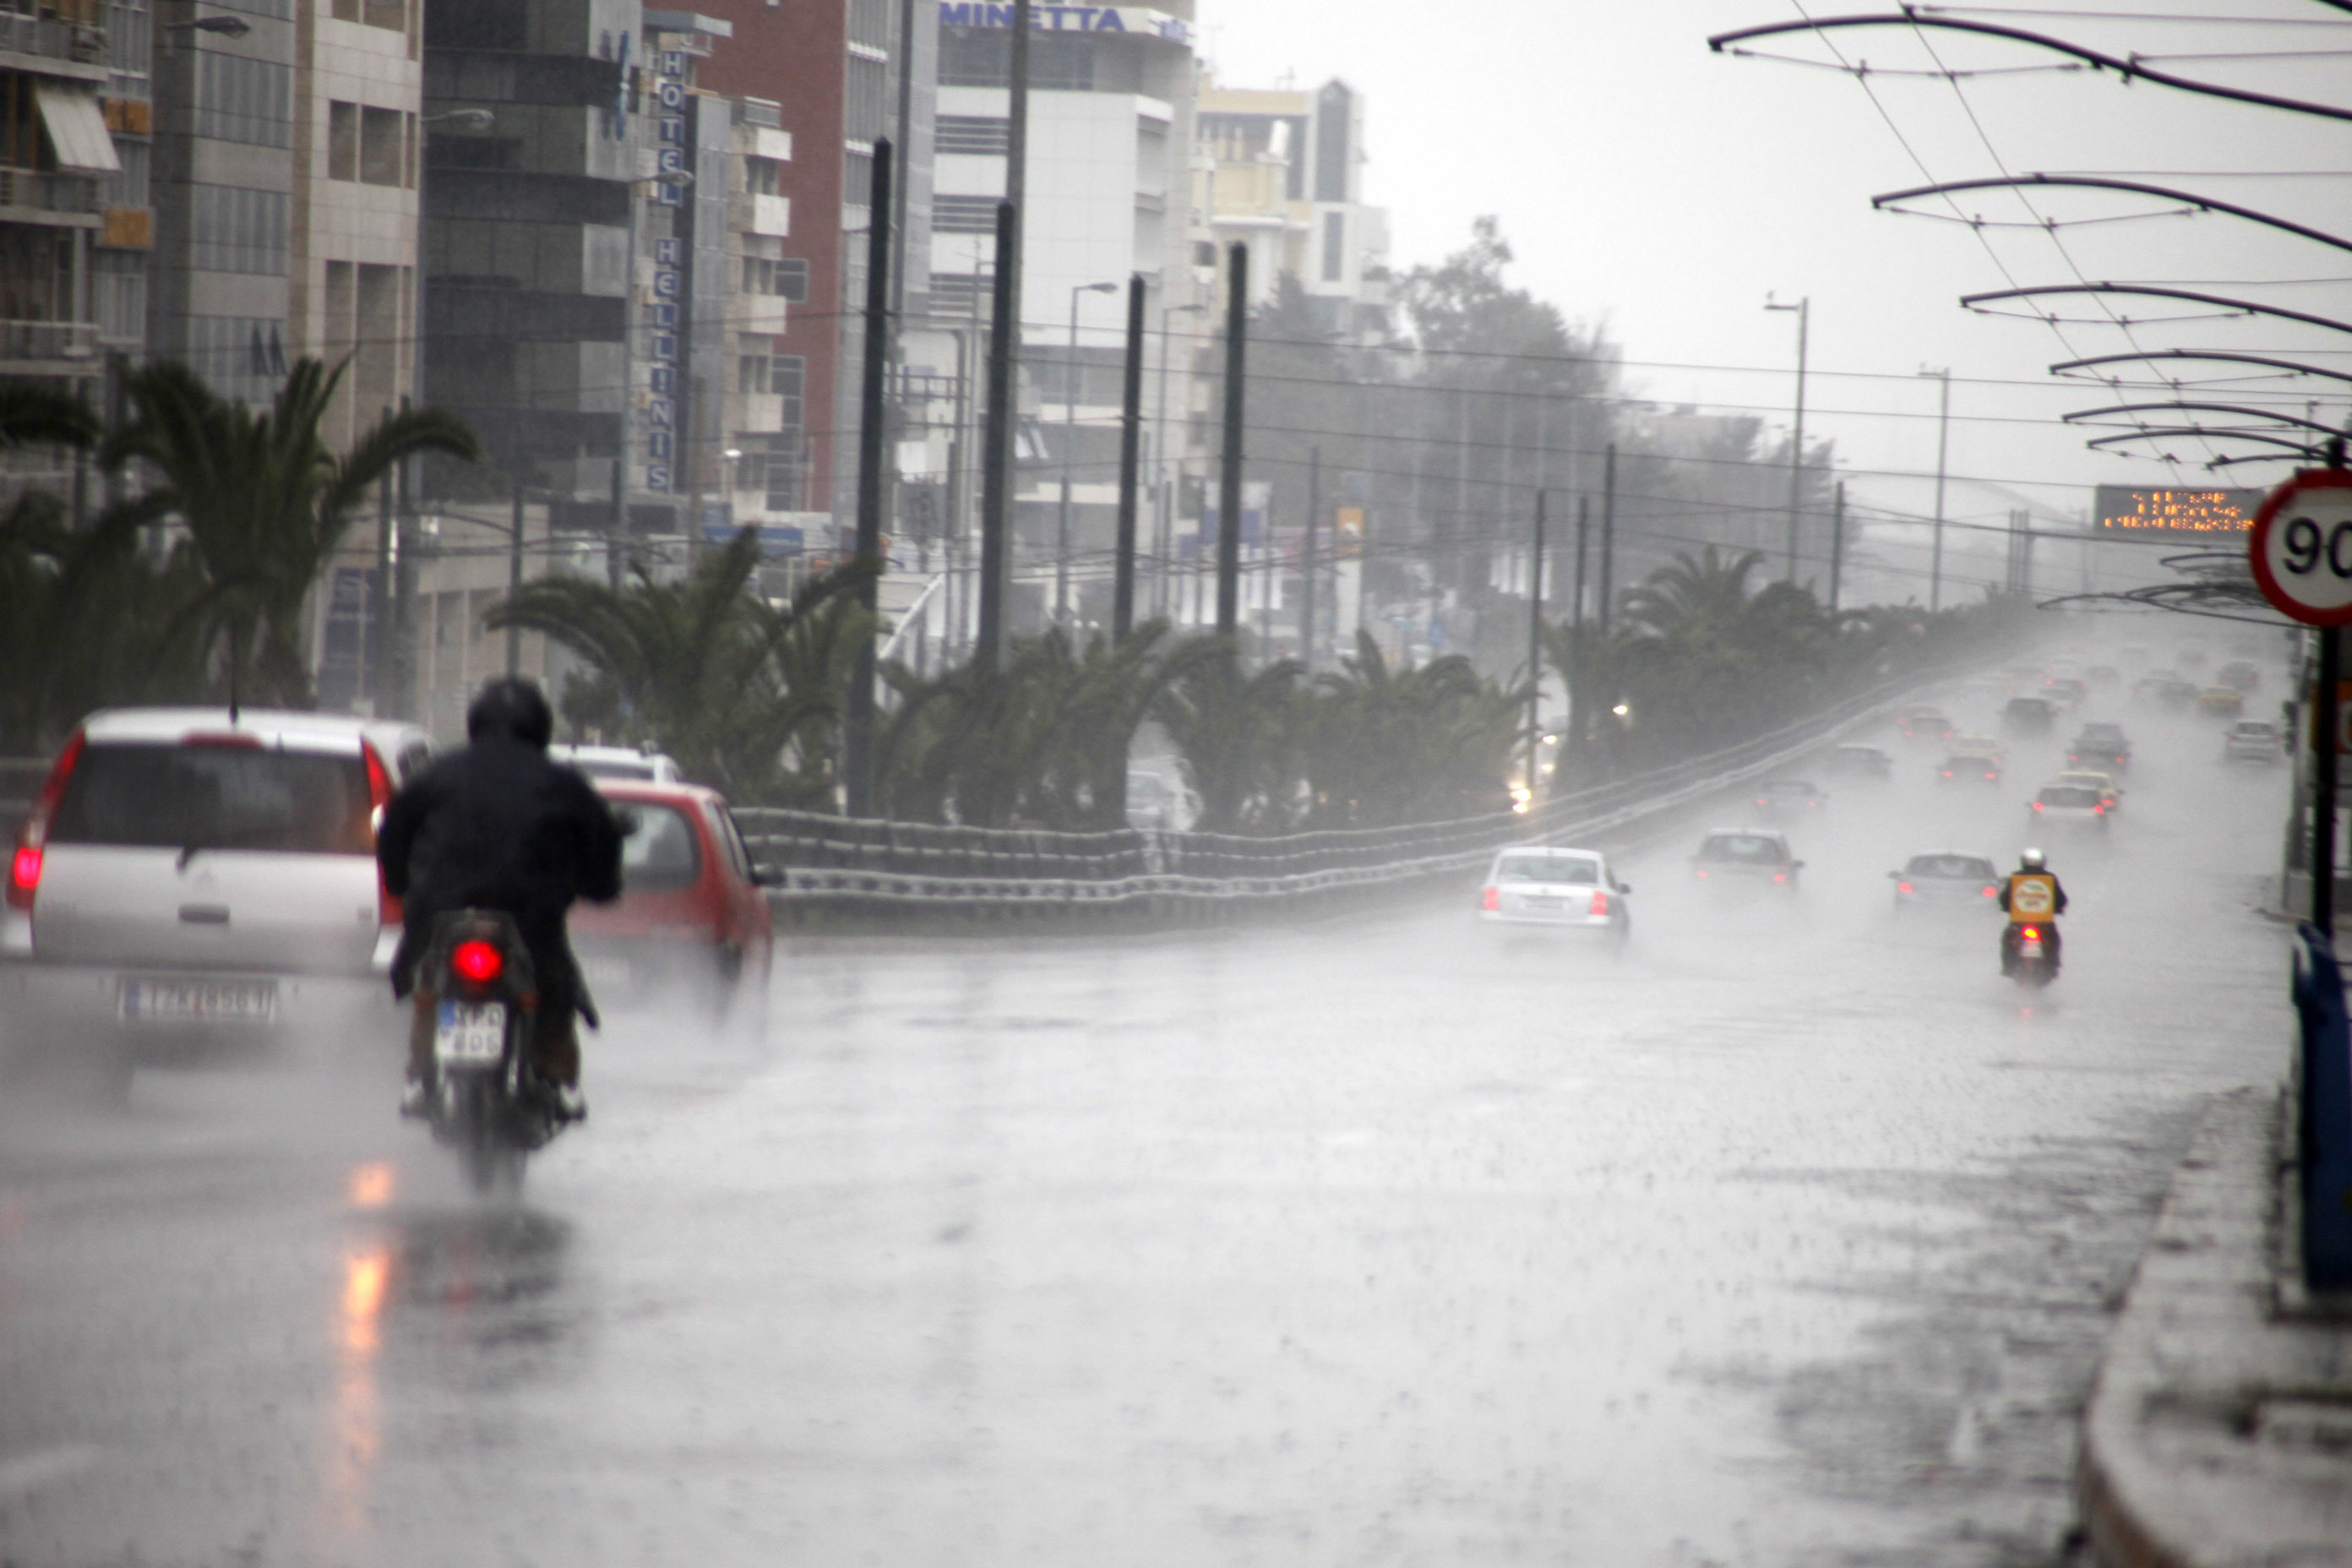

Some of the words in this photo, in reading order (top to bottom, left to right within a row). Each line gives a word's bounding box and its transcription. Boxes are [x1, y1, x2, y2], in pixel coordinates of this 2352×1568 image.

[939, 2, 1125, 31] MINETTA
[661, 52, 682, 204] HOTEL
[650, 242, 676, 487] HELLINIS
[2284, 517, 2352, 578] 90
